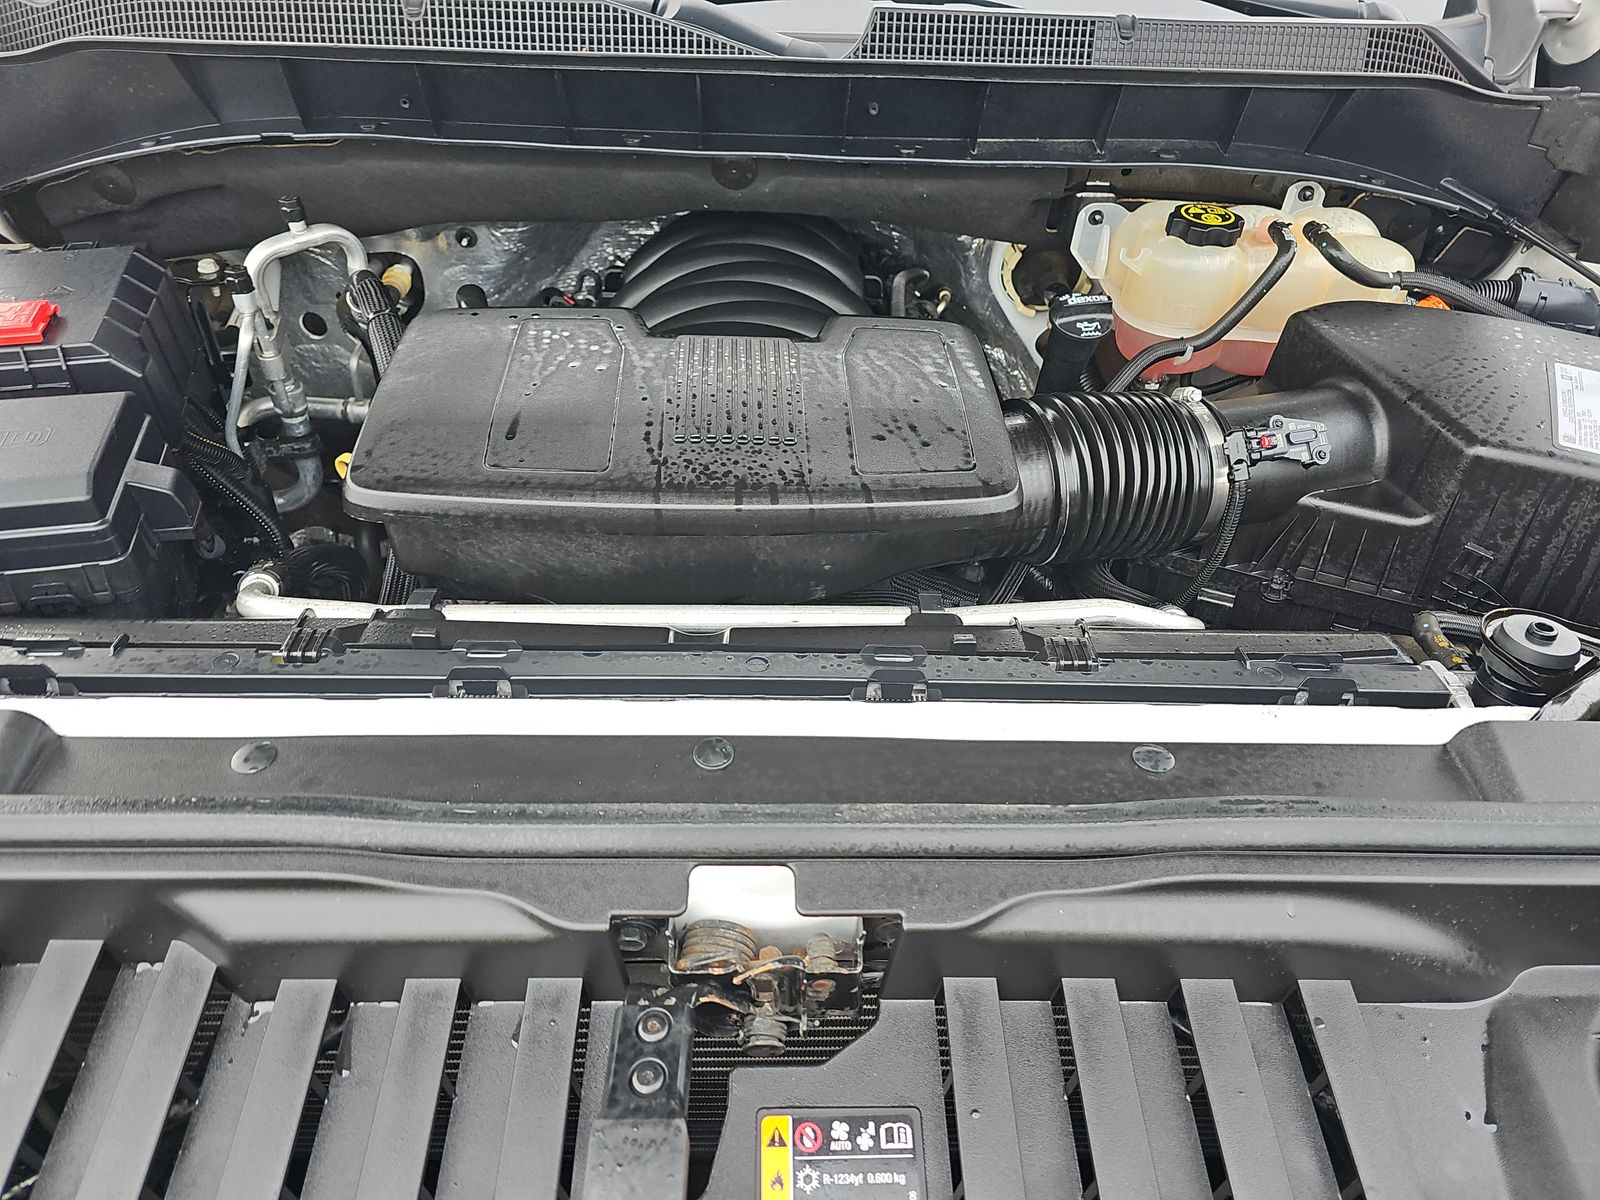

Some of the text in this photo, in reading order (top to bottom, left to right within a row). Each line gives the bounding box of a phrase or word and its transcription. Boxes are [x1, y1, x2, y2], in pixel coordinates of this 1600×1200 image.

[1067, 295, 1109, 305] dexos
[830, 1141, 852, 1151] AUTO
[822, 1172, 907, 1187] R-1234yf 0.600 kg
